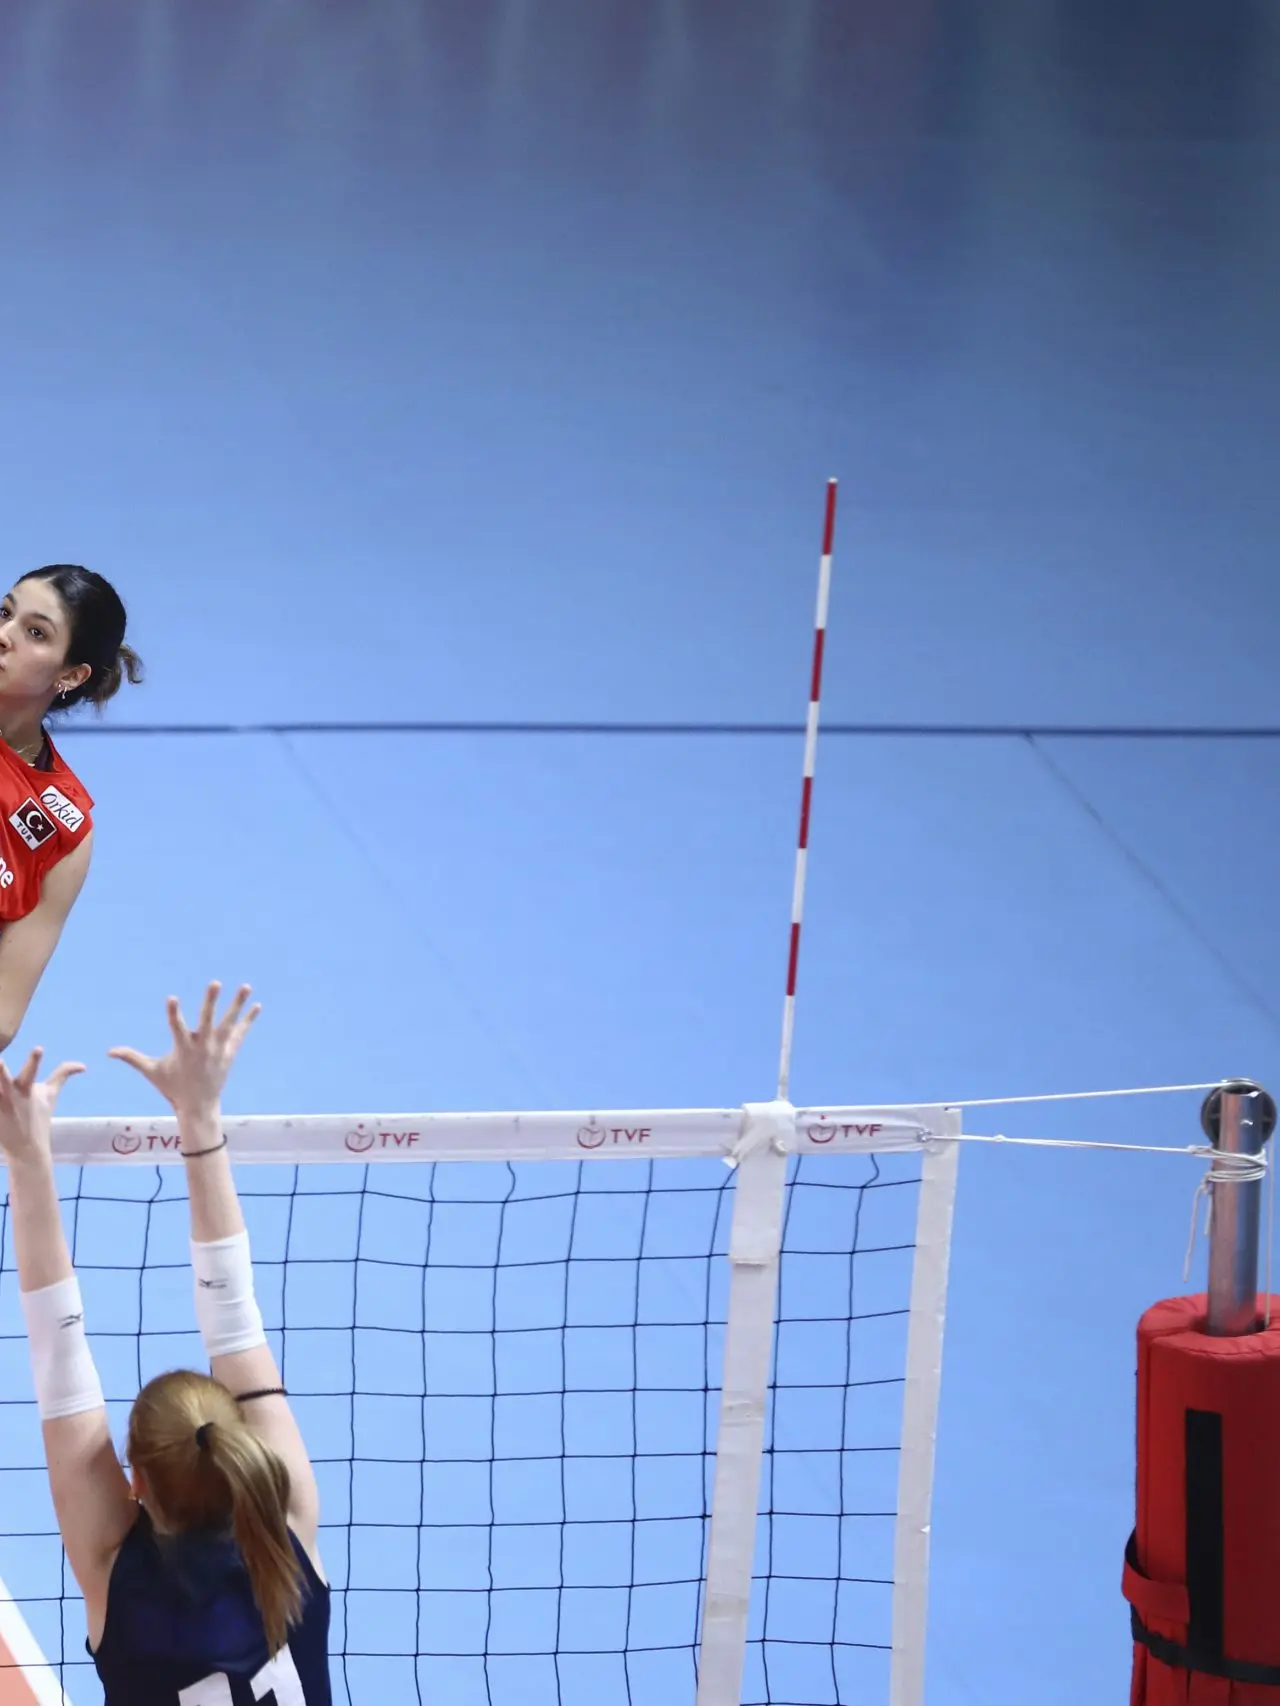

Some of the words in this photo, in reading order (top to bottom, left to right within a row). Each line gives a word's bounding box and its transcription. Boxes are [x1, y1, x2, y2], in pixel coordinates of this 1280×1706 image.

[41, 793, 83, 829] Orkid
[16, 821, 33, 842] TUR
[610, 1128, 652, 1144] TVF
[841, 1123, 883, 1138] TVF
[378, 1132, 421, 1148] TVF
[178, 1642, 308, 1706] 1
